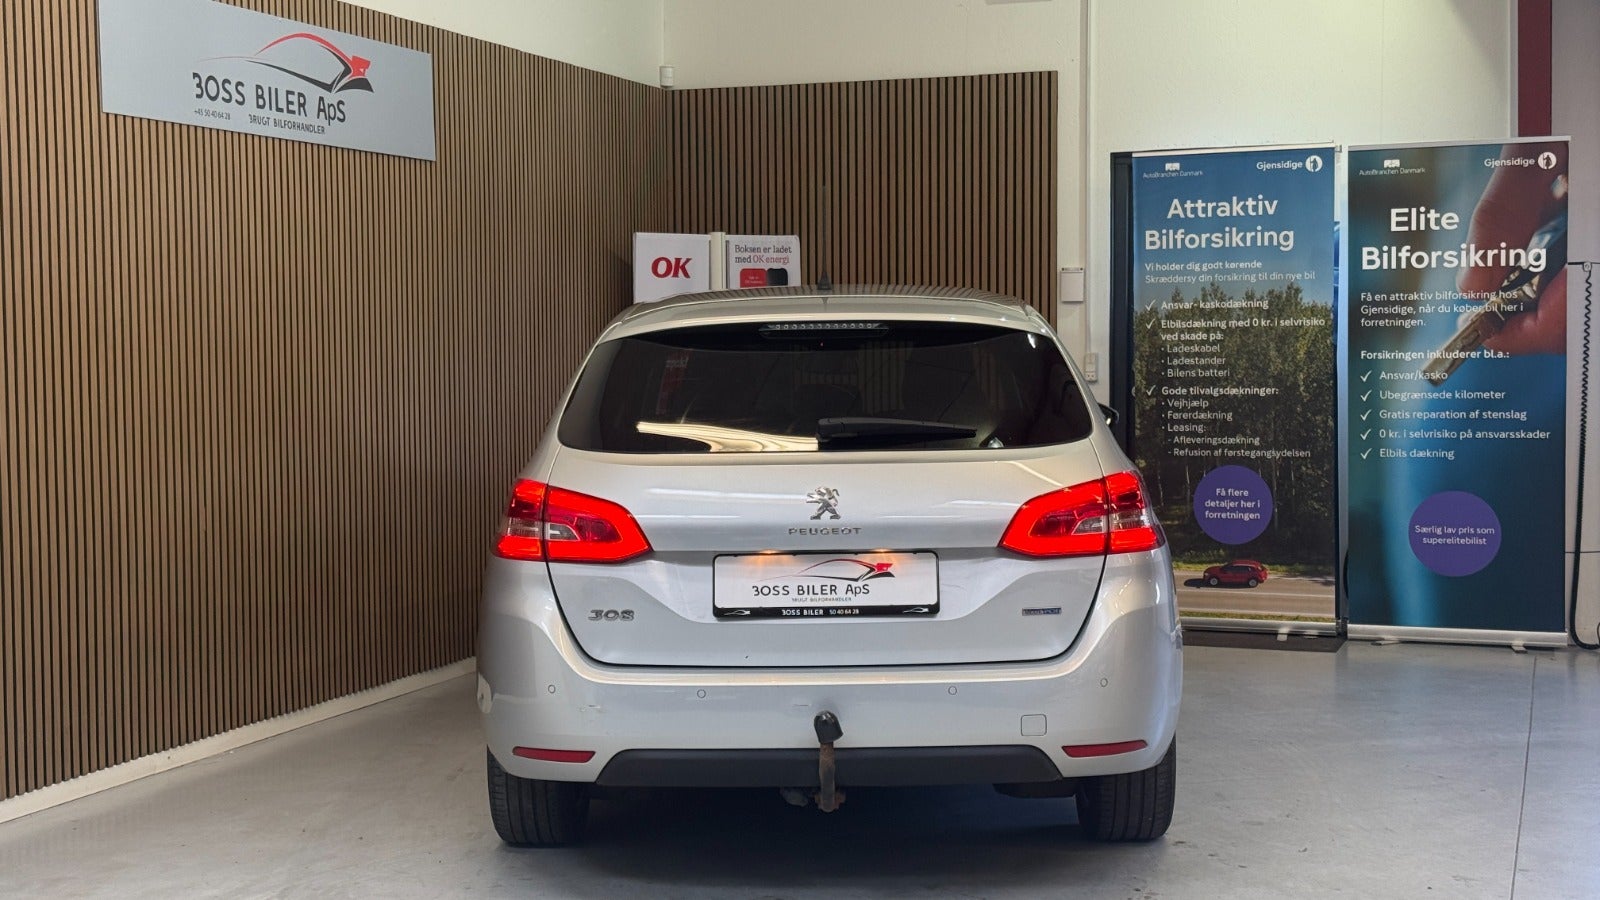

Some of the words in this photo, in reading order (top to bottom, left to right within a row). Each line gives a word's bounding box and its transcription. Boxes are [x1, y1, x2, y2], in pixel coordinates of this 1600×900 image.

[255, 84, 308, 117] BILER
[316, 95, 346, 126] ApS
[211, 110, 217, 118] 40
[218, 111, 224, 119] 64
[248, 114, 271, 126] BRUGT
[273, 118, 326, 135] BILFORHANDLER
[1256, 160, 1303, 172] Gjensidige
[1484, 157, 1535, 168] Gjensidige
[1167, 194, 1278, 219] Attraktiv
[1390, 206, 1460, 232] Elite
[1145, 226, 1294, 251] Bilforsikring
[734, 245, 761, 254] Boksen
[773, 245, 792, 254] ladet
[734, 255, 751, 264] med
[753, 255, 764, 263] OK
[765, 255, 790, 265] energi
[1361, 242, 1547, 273] Bilforsikring
[651, 256, 692, 278] OK
[1145, 263, 1154, 271] Vi
[1156, 262, 1184, 271] holder
[1186, 261, 1200, 272] dig
[1202, 261, 1223, 272] godt
[1225, 260, 1262, 269] kørende
[1145, 274, 1196, 285] Skræddersy
[1199, 273, 1212, 282] din
[1215, 272, 1257, 284] forsikring
[1258, 272, 1268, 280] til
[1269, 272, 1283, 280] din
[1285, 273, 1302, 282] nye
[1304, 271, 1316, 279] bil
[1361, 292, 1373, 301] Få
[1390, 292, 1433, 301] attraktiv
[1435, 291, 1497, 303] bilforsikring
[1499, 290, 1518, 299] hos
[1200, 299, 1269, 309] kaskodækning
[1361, 305, 1416, 316] Gjensidige,
[1419, 304, 1435, 313] når
[1438, 304, 1451, 313] du
[1453, 304, 1483, 313] køber
[1485, 303, 1498, 312] bil
[1501, 303, 1518, 312] her
[1161, 320, 1227, 330] Elbilsdækning
[1228, 319, 1250, 327] med
[1252, 318, 1259, 327] 0
[1261, 318, 1272, 327] kr.
[1280, 317, 1325, 327] selvrisiko
[1361, 318, 1426, 329] forretningen.
[1161, 332, 1179, 341] ved
[1180, 332, 1207, 341] skade
[1209, 331, 1224, 342] på:
[1167, 344, 1221, 353] Ladeskabel
[1361, 350, 1425, 361] Forsikringen
[1427, 350, 1482, 359] inkluderer
[1484, 350, 1510, 359] bl.a.:
[1167, 357, 1226, 366] Ladestander
[1167, 369, 1196, 378] Bilens
[1198, 368, 1230, 377] batteri
[1380, 371, 1448, 381] Ansvar/kasko
[1161, 386, 1188, 396] Gode
[1189, 386, 1279, 397] tilvalgsdækninger:
[1380, 391, 1452, 402] Ubegrænsede
[1455, 390, 1506, 399] kilometer
[1167, 399, 1209, 409] Vejhjælp
[1167, 411, 1233, 421] Førerdækning
[1379, 410, 1410, 419] Gratis
[1412, 410, 1466, 421] reparation
[1469, 410, 1479, 419] af
[1482, 410, 1527, 421] stenslag
[1379, 430, 1386, 439] 0
[1388, 430, 1400, 439] kr.
[1409, 429, 1457, 439] selvrisiko
[1460, 429, 1473, 440] på
[1475, 430, 1551, 439] ansvarsskader
[1173, 435, 1260, 446] Afleveringsdækning
[1173, 448, 1212, 457] Refusion
[1213, 449, 1222, 457] af
[1224, 448, 1311, 459] førstegangsydelsen
[1380, 449, 1407, 458] Elbils
[1409, 449, 1455, 460] dækning
[1216, 488, 1226, 497] Få
[1228, 488, 1249, 497] flere
[1205, 499, 1238, 510] detaljer
[1241, 500, 1256, 508] her
[1205, 511, 1261, 521] forretningen
[788, 527, 862, 535] PEUGEOT
[1415, 525, 1442, 535] Særlig
[1444, 526, 1457, 534] lav
[1458, 526, 1475, 535] pris
[1423, 537, 1487, 545] superelitebilist
[797, 584, 838, 596] BILER
[845, 584, 870, 597] ApS
[588, 609, 635, 621] 308
